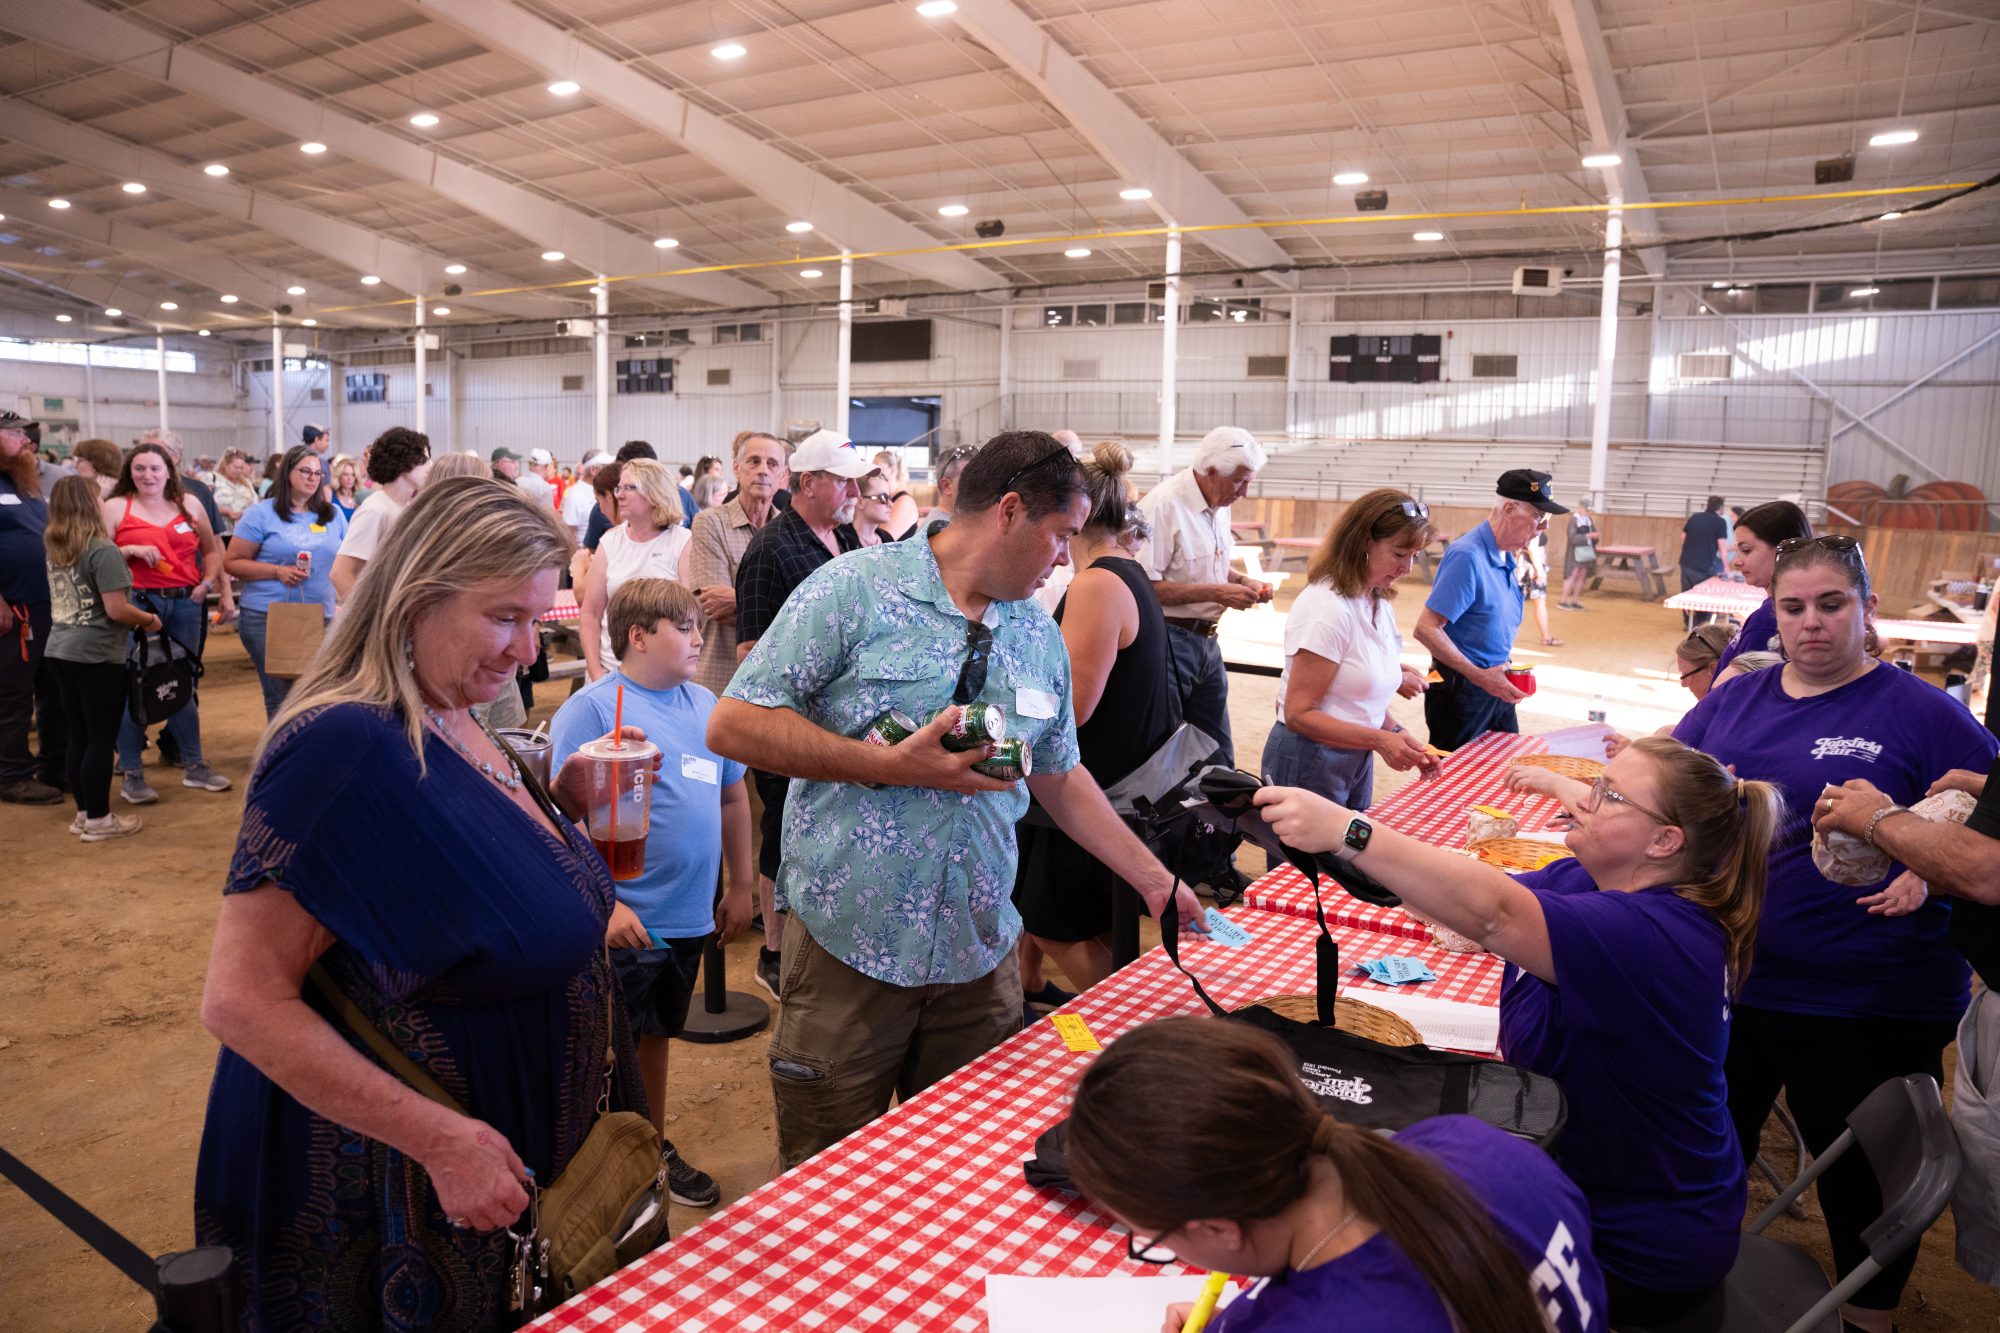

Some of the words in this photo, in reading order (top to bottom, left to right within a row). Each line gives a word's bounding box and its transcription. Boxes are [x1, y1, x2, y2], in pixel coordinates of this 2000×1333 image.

[1810, 747, 1857, 760] Fair
[1814, 736, 1884, 754] Topsfield
[633, 768, 645, 803] ICED
[1948, 808, 1970, 822] YE
[1299, 1078, 1373, 1105] Topsfie
[1317, 1076, 1373, 1093] Fair
